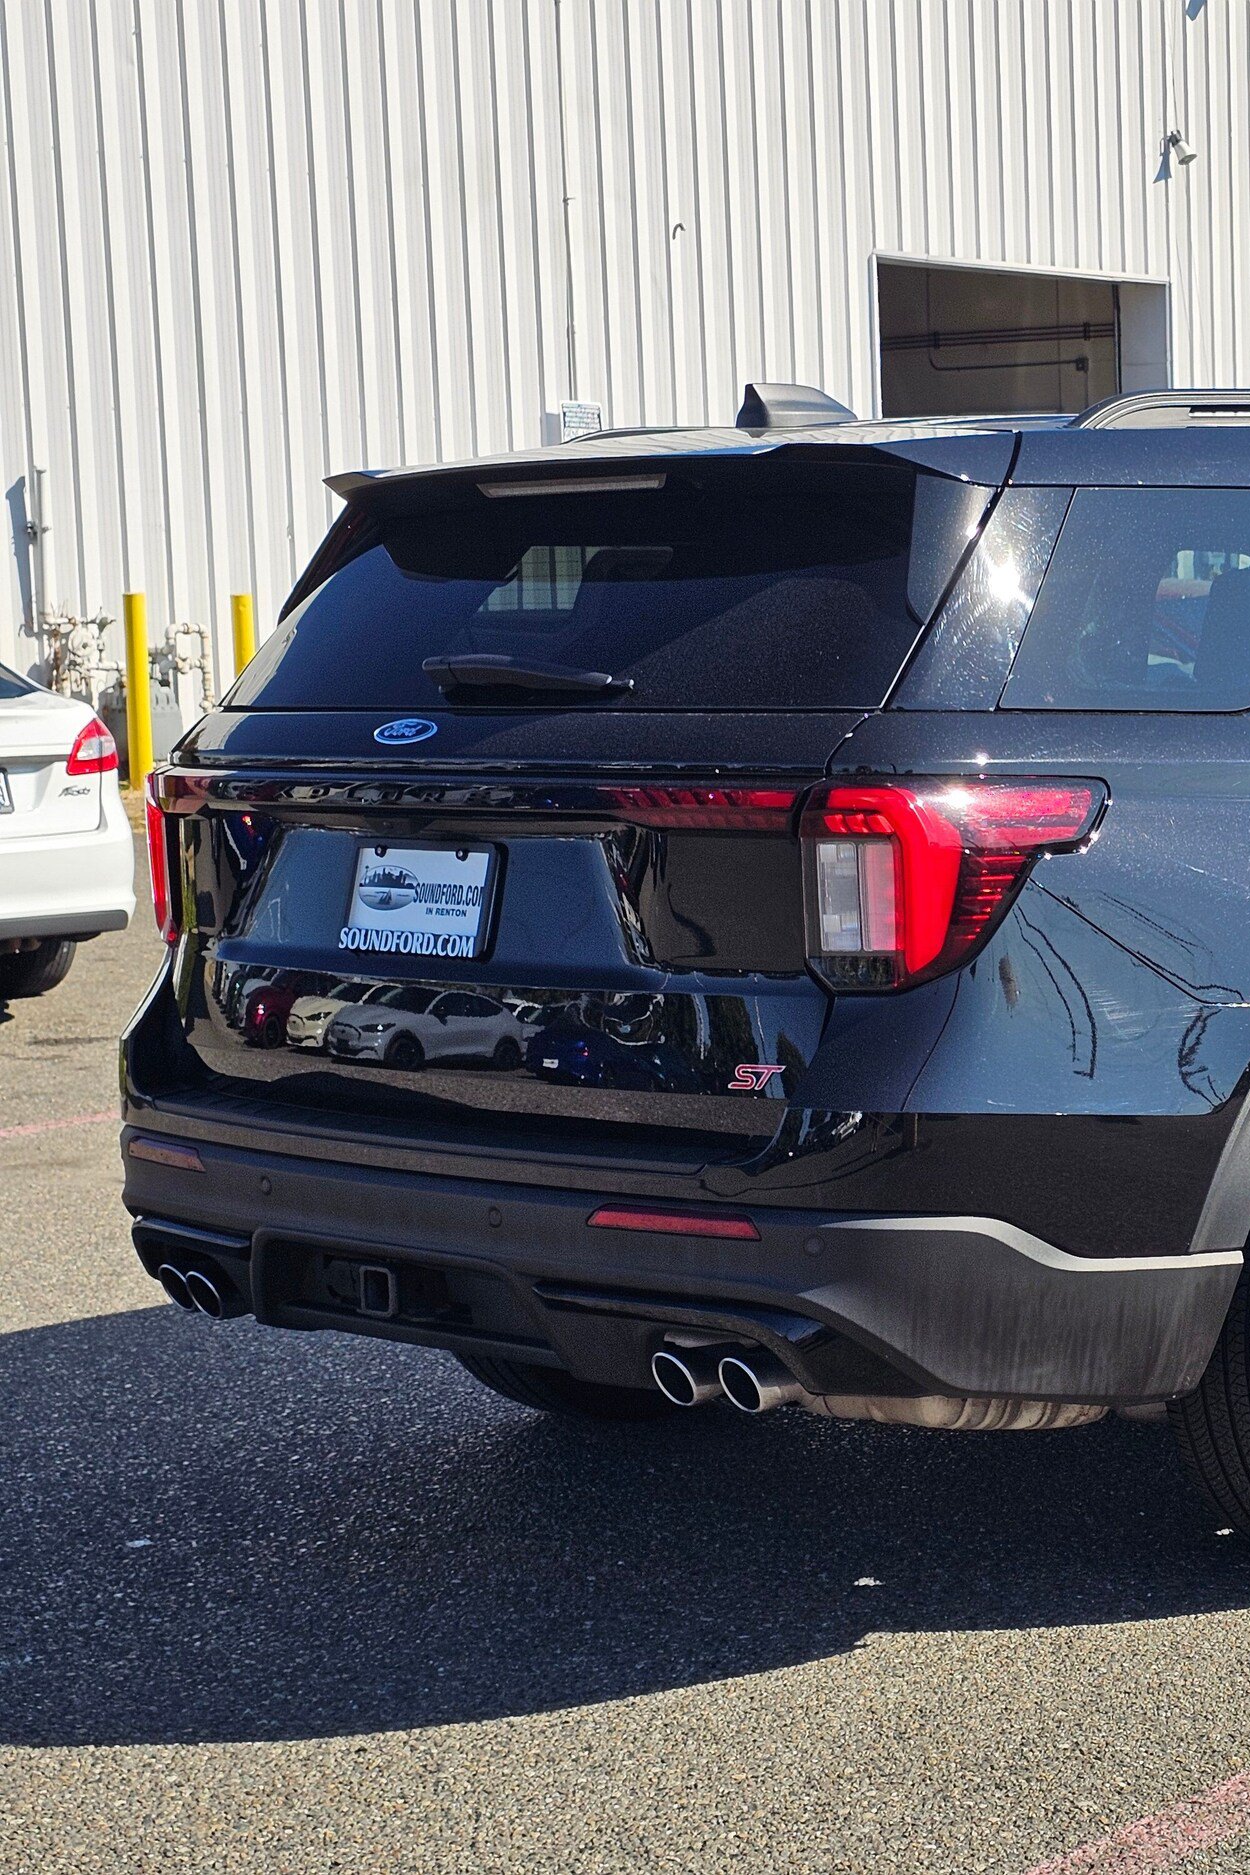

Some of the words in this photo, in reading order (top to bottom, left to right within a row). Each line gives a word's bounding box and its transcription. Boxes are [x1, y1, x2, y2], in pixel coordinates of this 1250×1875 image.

[425, 907, 434, 916] IN
[435, 907, 467, 918] RENTON
[338, 926, 476, 958] SOUNDFORD.COM
[727, 1063, 787, 1091] ST
